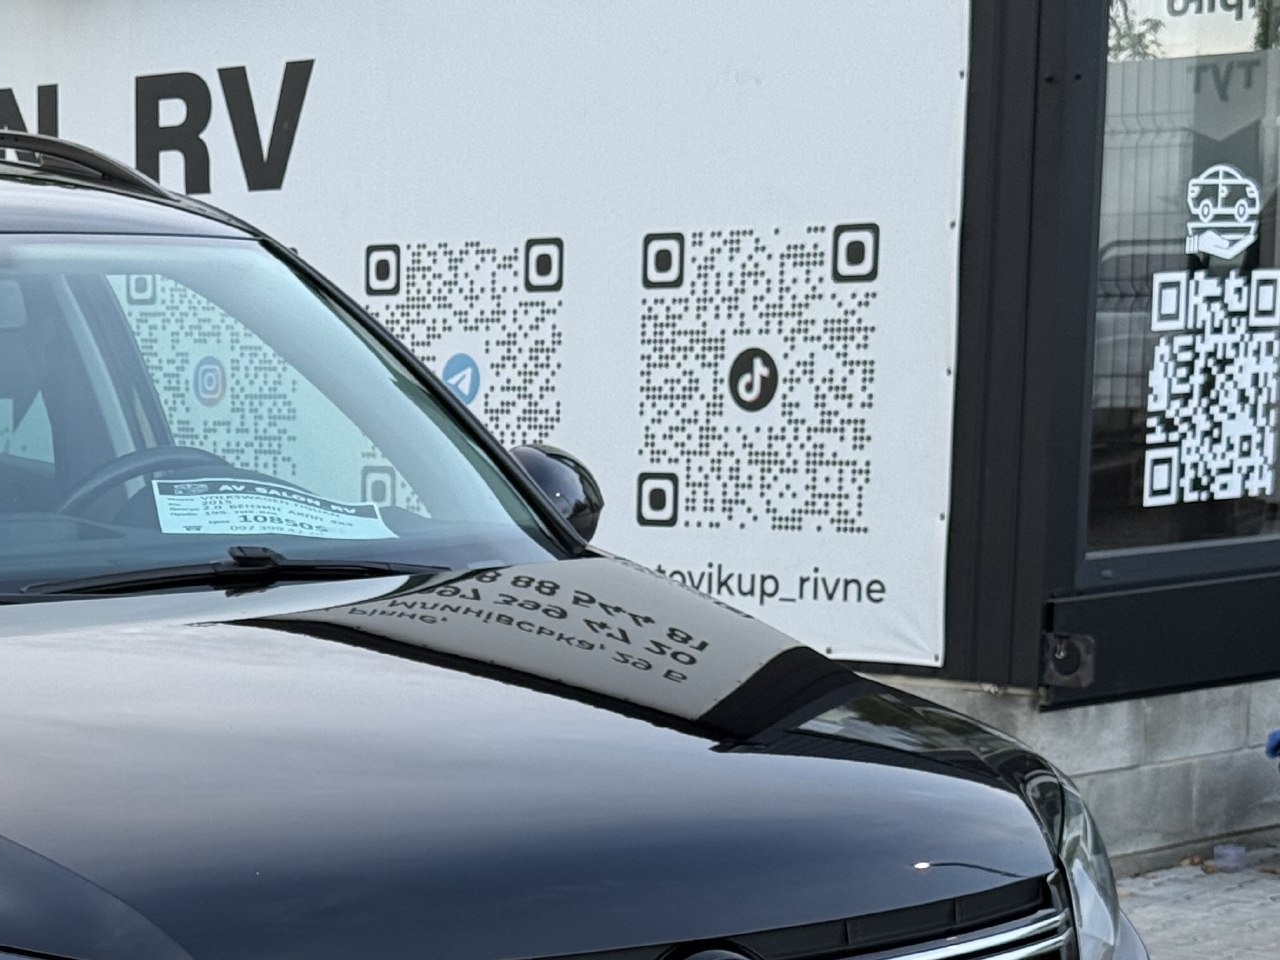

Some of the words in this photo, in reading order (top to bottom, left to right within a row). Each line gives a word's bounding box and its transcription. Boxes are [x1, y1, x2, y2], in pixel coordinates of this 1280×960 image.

[135, 59, 316, 195] RV
[219, 484, 245, 492] AV
[254, 487, 320, 506] SALON
